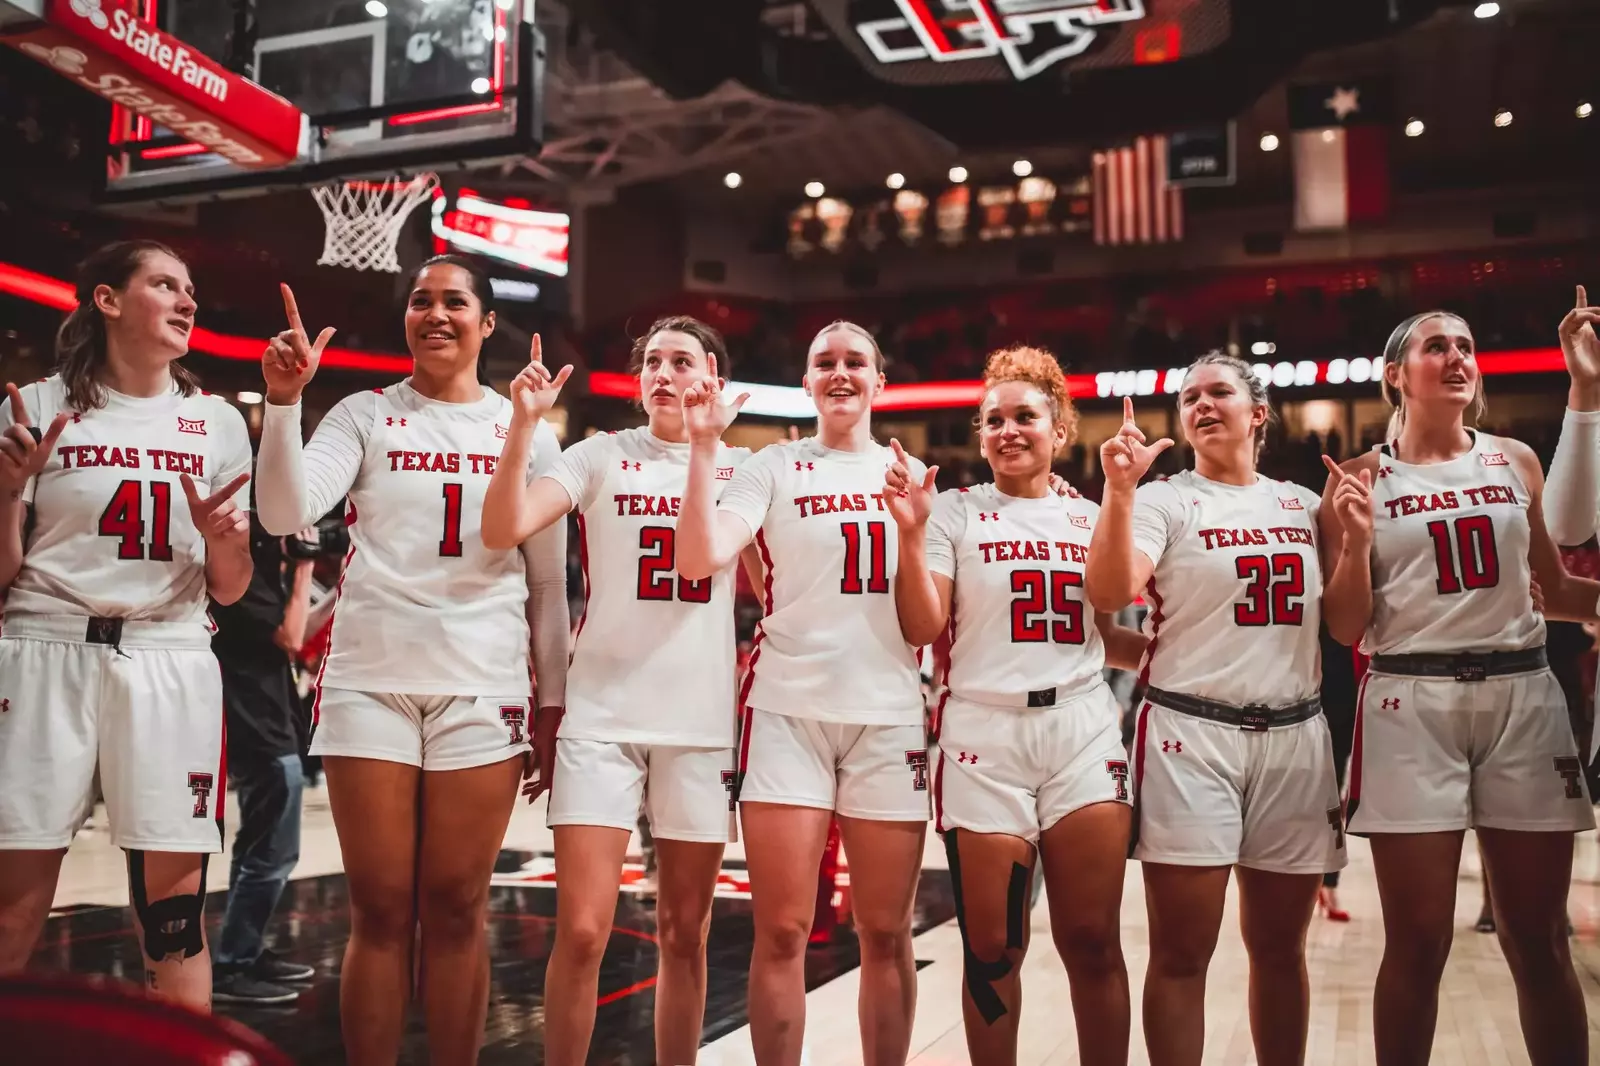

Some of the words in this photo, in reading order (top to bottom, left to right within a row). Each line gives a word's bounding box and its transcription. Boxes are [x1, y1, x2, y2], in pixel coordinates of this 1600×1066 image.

[58, 445, 140, 469] TEXAS
[147, 449, 204, 477] TECH
[387, 451, 460, 473] TEXAS
[467, 454, 500, 475] TE
[614, 495, 681, 517] TEXAS
[794, 494, 867, 518] TEXAS
[1385, 491, 1459, 519] TEXAS
[1462, 485, 1518, 506] TECH
[98, 479, 173, 561] 41
[439, 483, 463, 557] 1
[979, 541, 1050, 563] TEXAS
[1055, 542, 1088, 564] TEC
[1198, 528, 1268, 550] TEXAS
[1268, 527, 1314, 548] TECH
[1426, 514, 1499, 595] 10
[840, 521, 889, 594] 11
[1234, 553, 1305, 626] 32
[1010, 569, 1085, 645] 25
